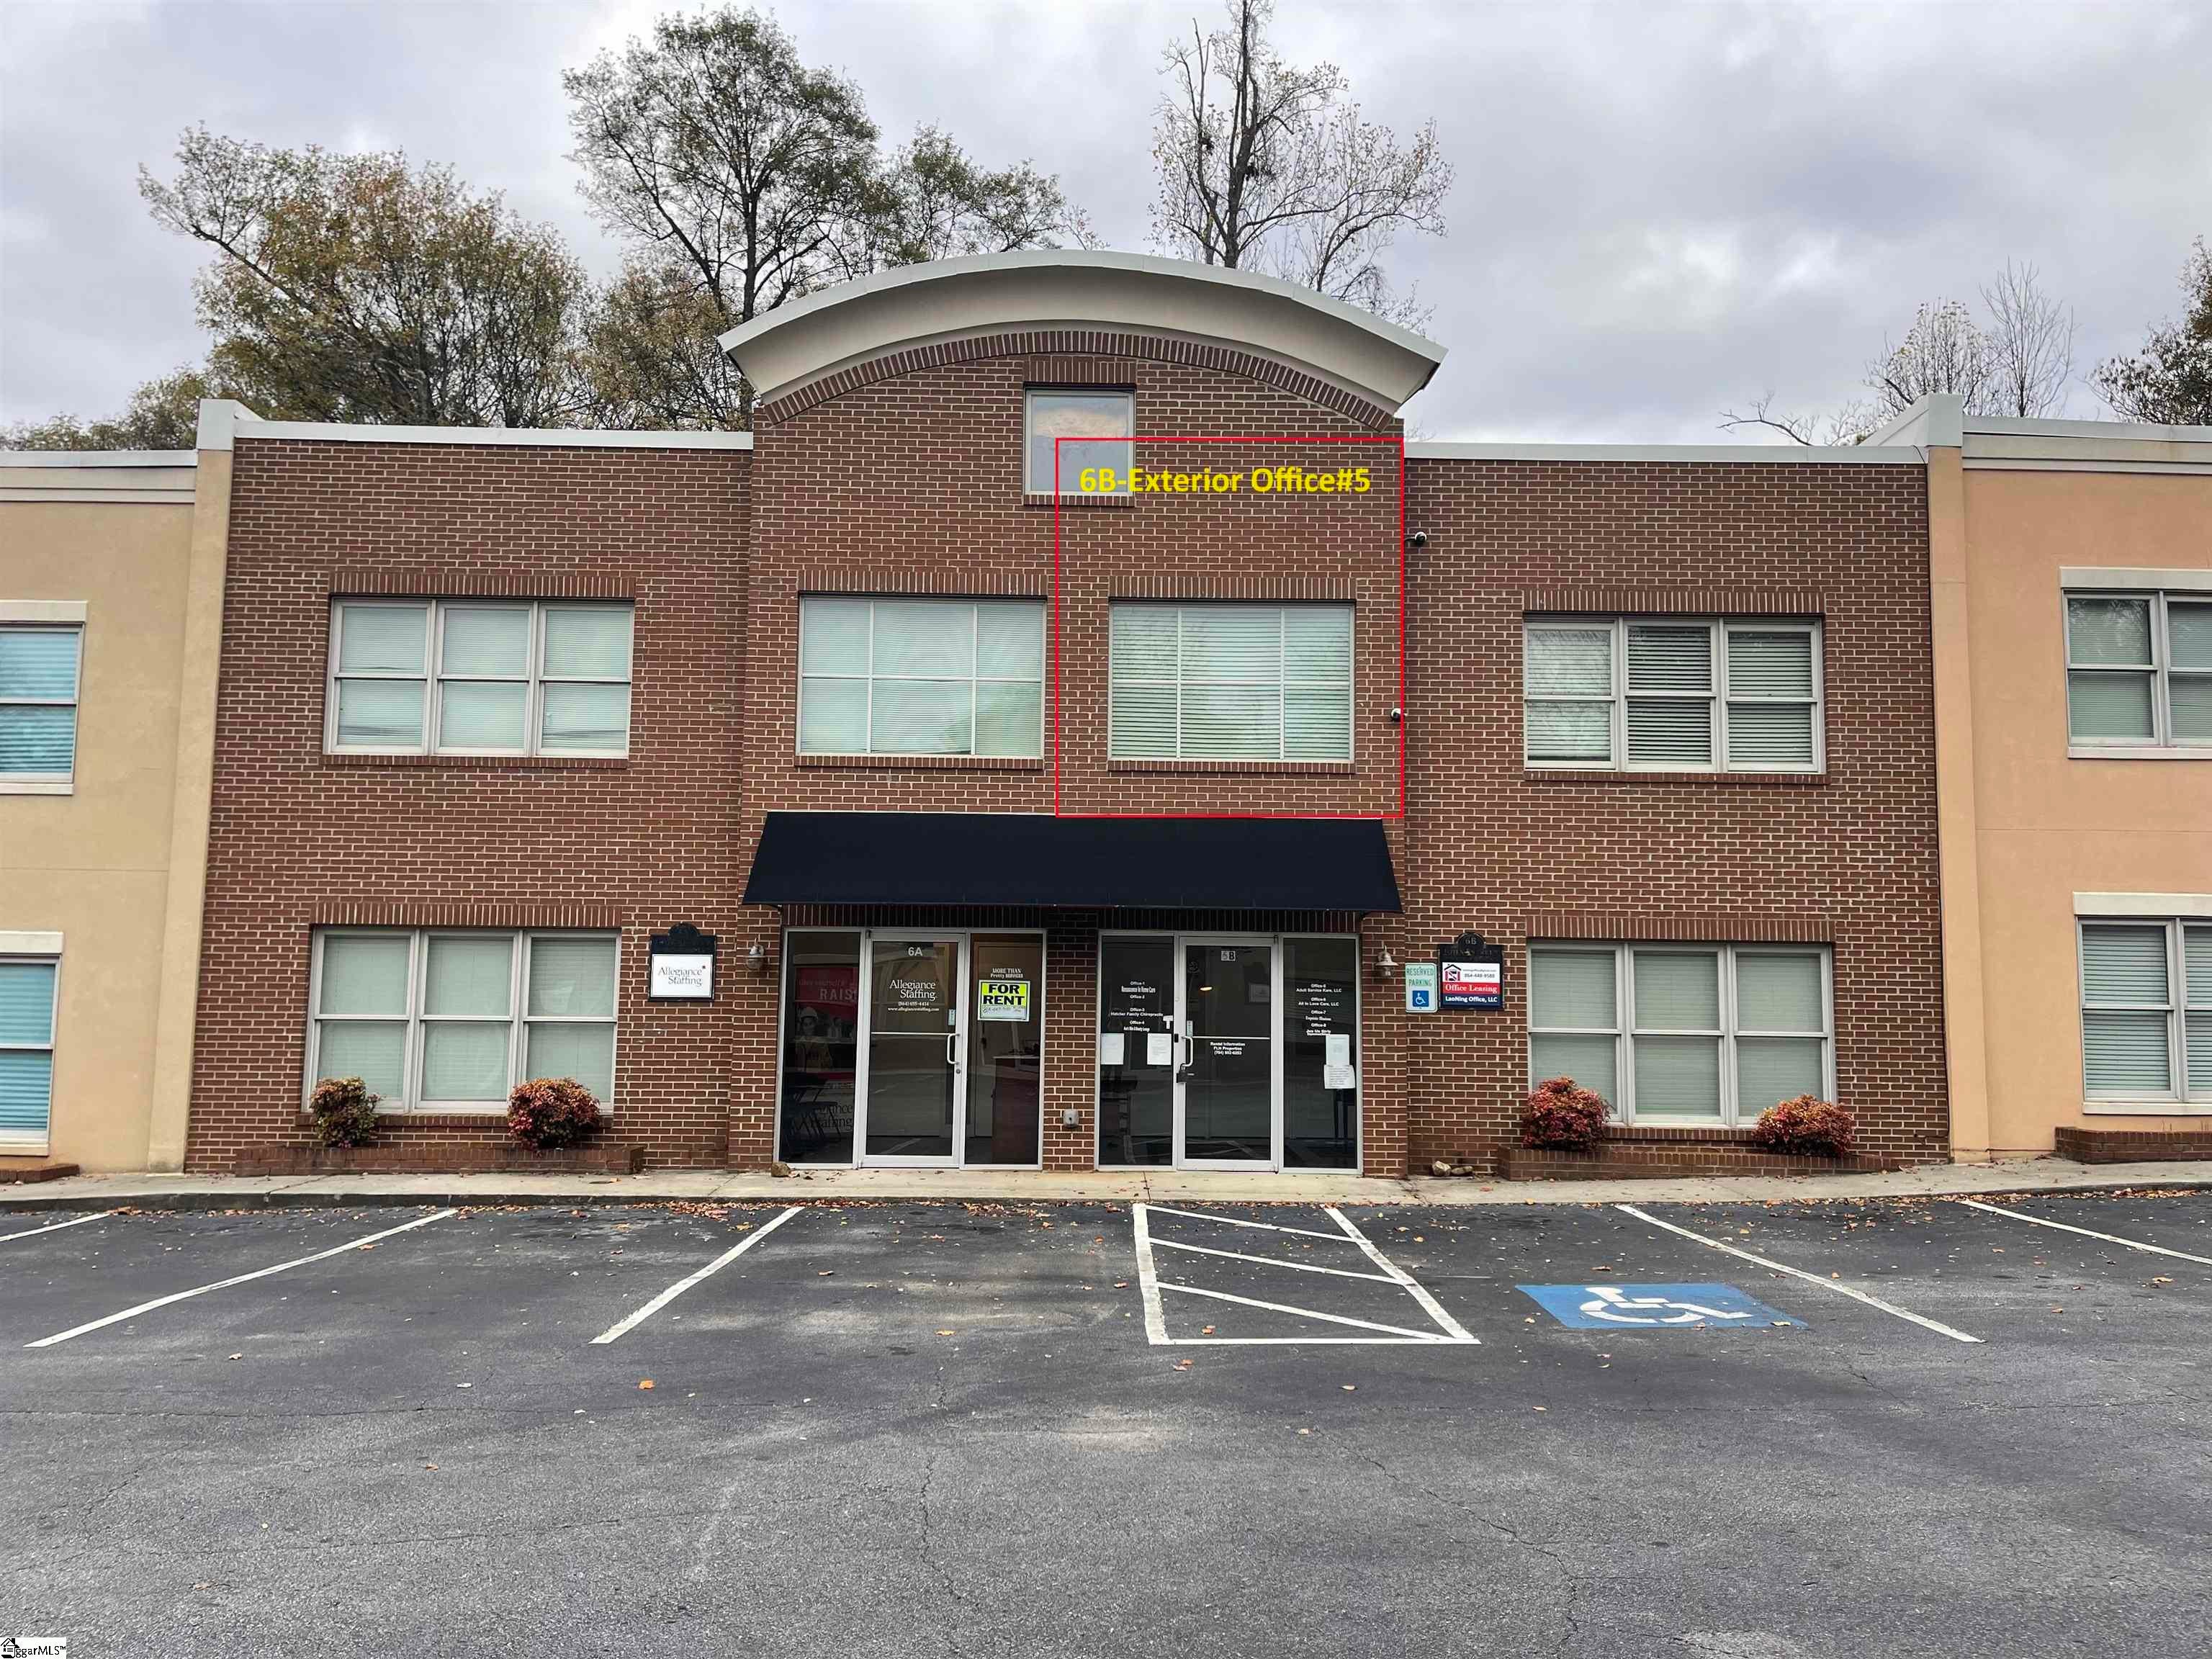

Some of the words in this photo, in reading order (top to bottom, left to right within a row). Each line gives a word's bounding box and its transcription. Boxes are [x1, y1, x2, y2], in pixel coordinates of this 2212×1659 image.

[908, 947, 922, 956] 6A
[657, 966, 702, 978] Allegiance
[668, 976, 702, 987] Staffing
[889, 979, 936, 992] Allegiance
[989, 984, 1020, 994] FOR
[1469, 984, 1498, 994] Leasing
[900, 989, 936, 1002] Staffing
[983, 995, 1025, 1004] RENT
